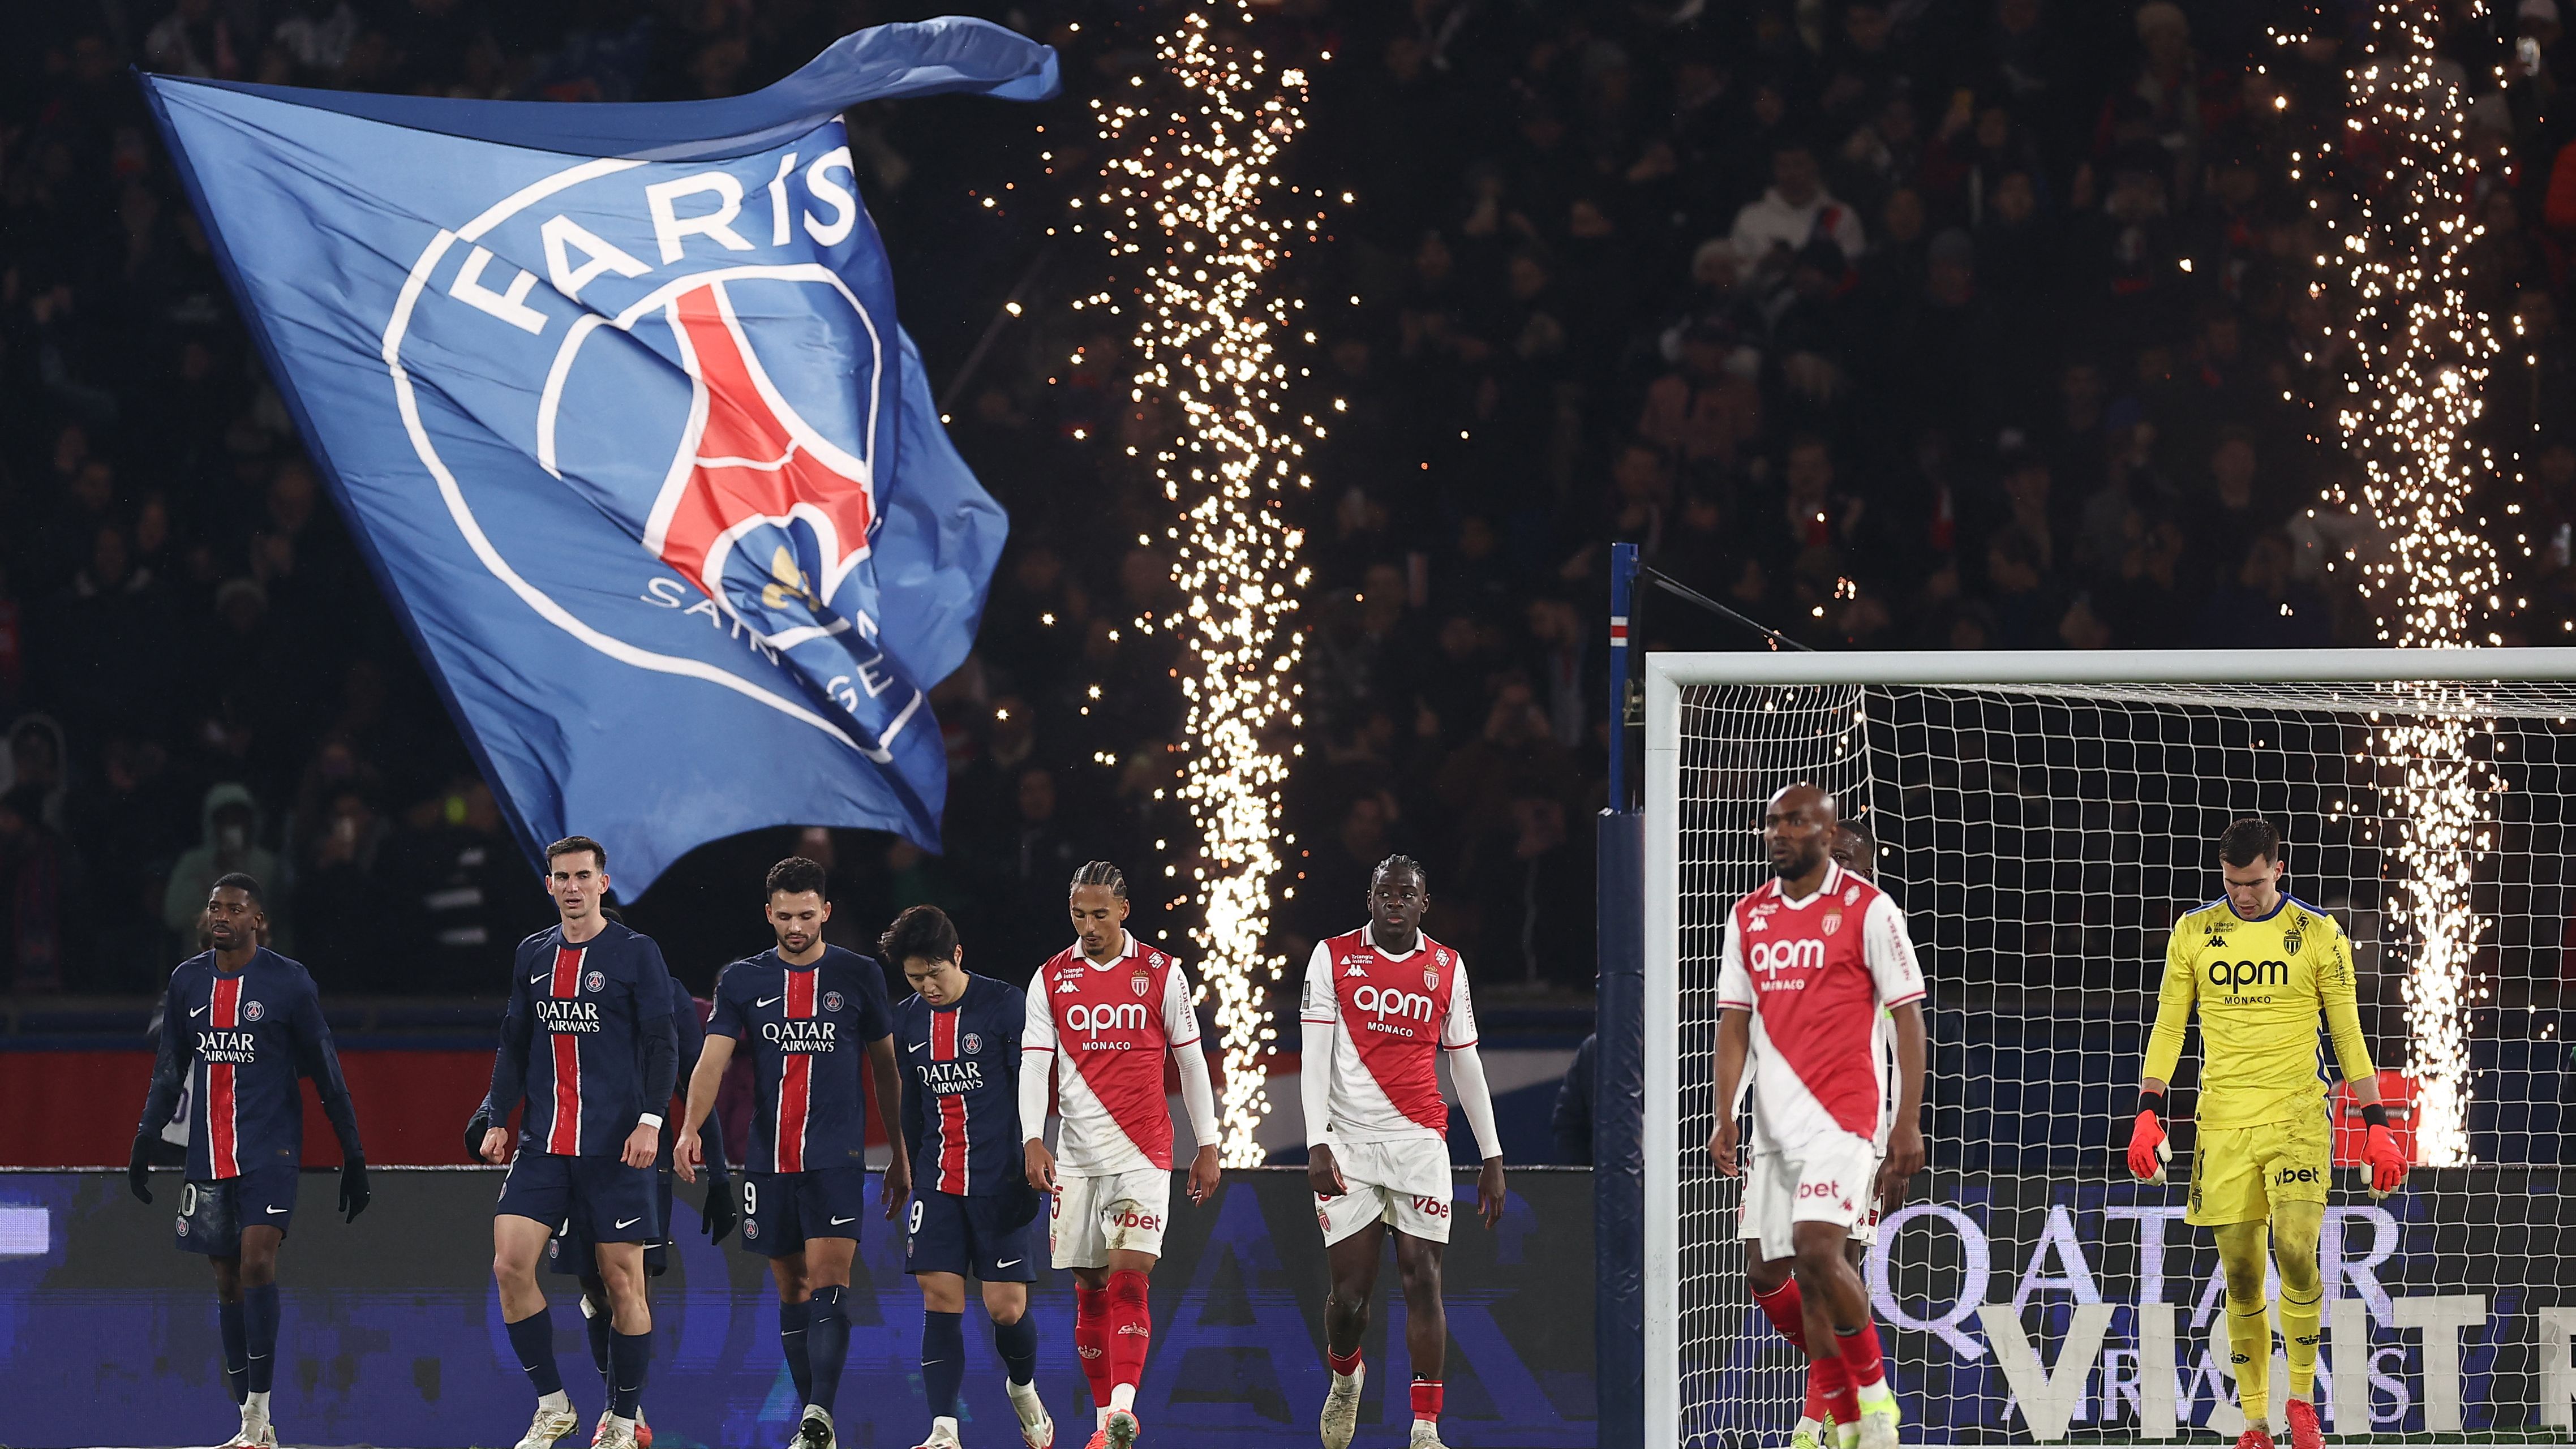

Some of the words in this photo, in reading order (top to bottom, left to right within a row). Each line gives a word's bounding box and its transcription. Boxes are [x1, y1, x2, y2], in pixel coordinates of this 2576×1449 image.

[640, 577, 804, 685] SAIN
[1750, 939, 1825, 980] apm
[2209, 960, 2289, 994] apm
[536, 1000, 599, 1023] QATAR
[1177, 974, 1193, 1033] VREDESTEIN
[1353, 985, 1433, 1024] apm
[2224, 996, 2272, 1005] MONACO
[547, 1020, 600, 1033] AIRWAYS
[762, 1021, 836, 1044] QATAR
[1066, 1003, 1147, 1040] apm
[1367, 1021, 1414, 1038] MONACO
[196, 1031, 255, 1054] QATAR
[780, 1040, 835, 1053] AIRWAYS
[1082, 1041, 1131, 1051] MONACO
[204, 1050, 255, 1063] AIRWAYS
[917, 1061, 982, 1087] QATAR
[931, 1078, 984, 1094] AIRWAYS
[2274, 1166, 2320, 1187] vbet
[178, 1183, 197, 1216] 0
[744, 1181, 757, 1215] 9
[1794, 1180, 1839, 1199] bet
[1051, 1185, 1064, 1220] 5
[1412, 1195, 1449, 1218] vbe
[908, 1200, 924, 1234] 9
[1114, 1210, 1161, 1232] vbet
[1976, 1295, 2486, 1441] VISIT
